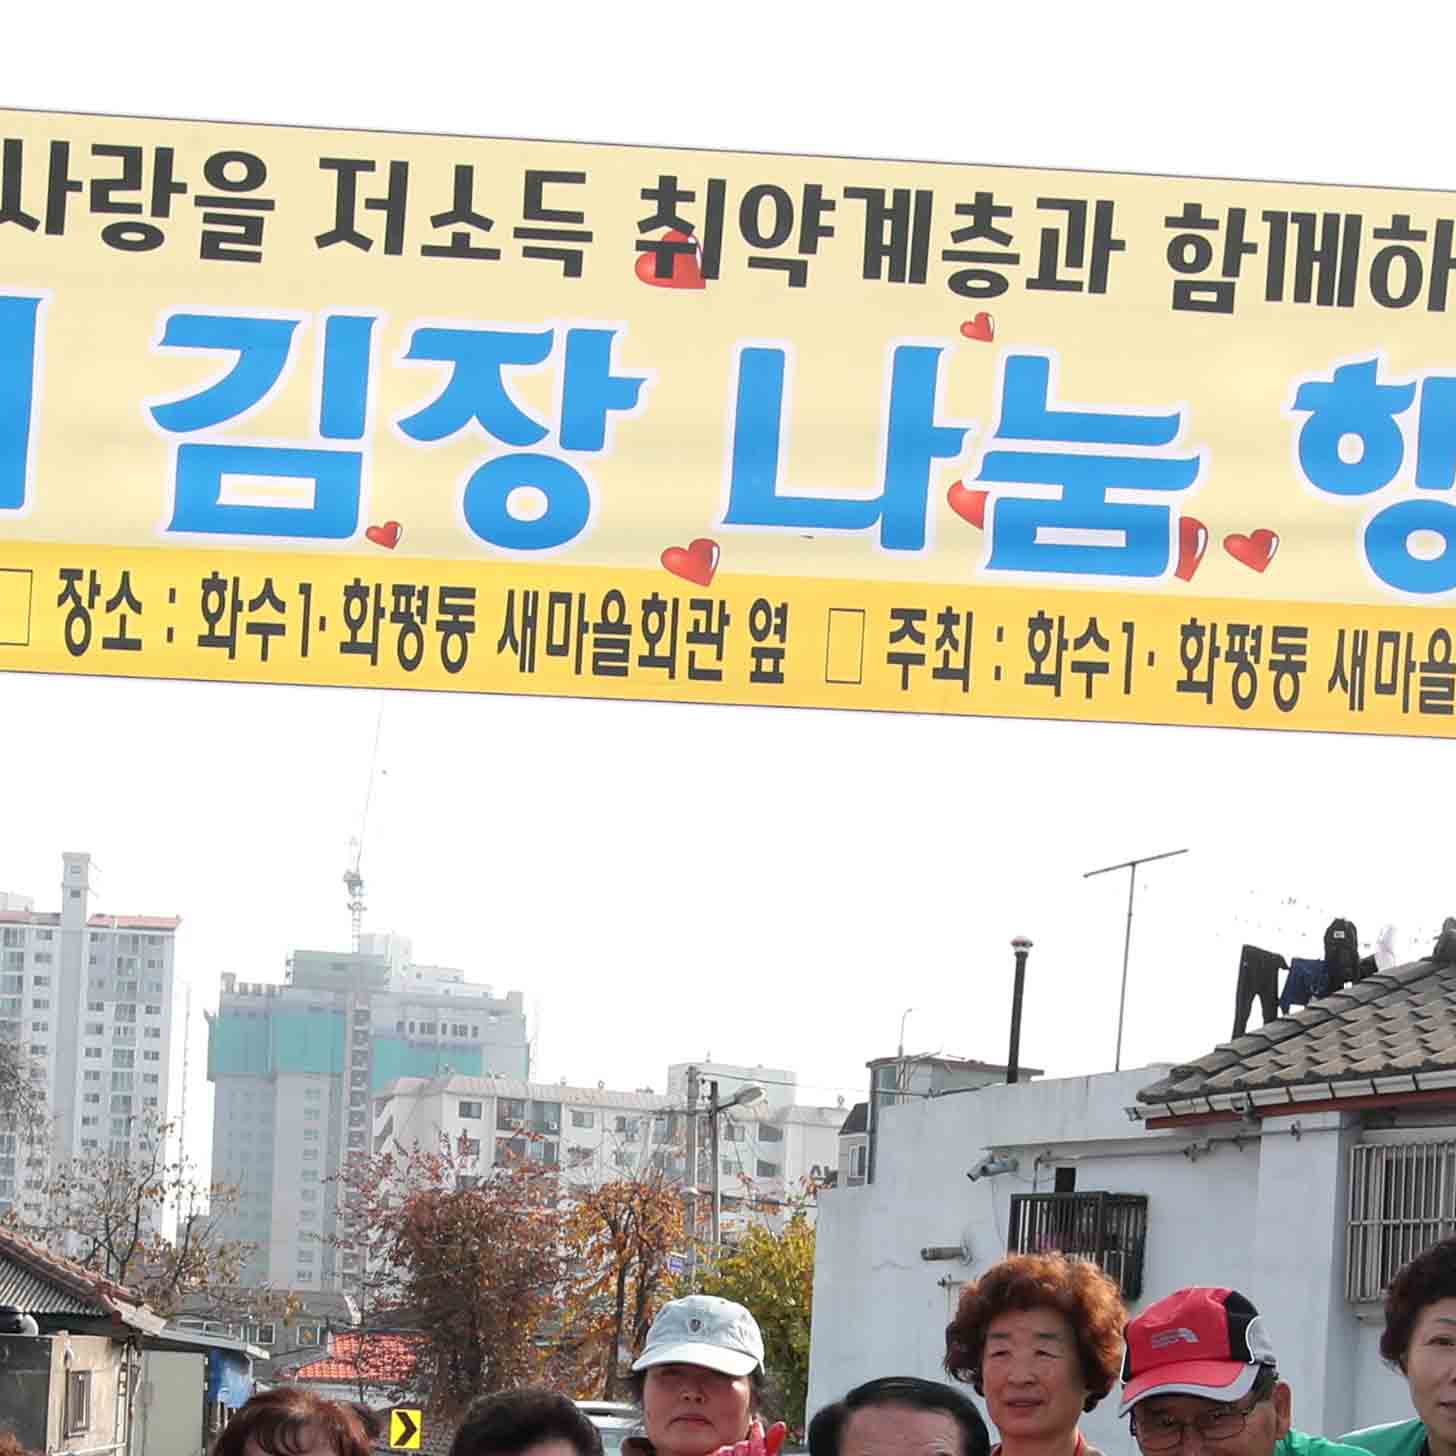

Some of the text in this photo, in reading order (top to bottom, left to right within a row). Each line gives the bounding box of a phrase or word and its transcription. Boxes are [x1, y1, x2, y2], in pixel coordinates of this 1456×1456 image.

[315, 155, 594, 278] 저소득
[634, 174, 1126, 300] 취약계층과
[148, 312, 647, 552] 김장
[721, 344, 1201, 580] 나눔
[496, 587, 730, 682] 새마을회관
[748, 599, 789, 685] 옆
